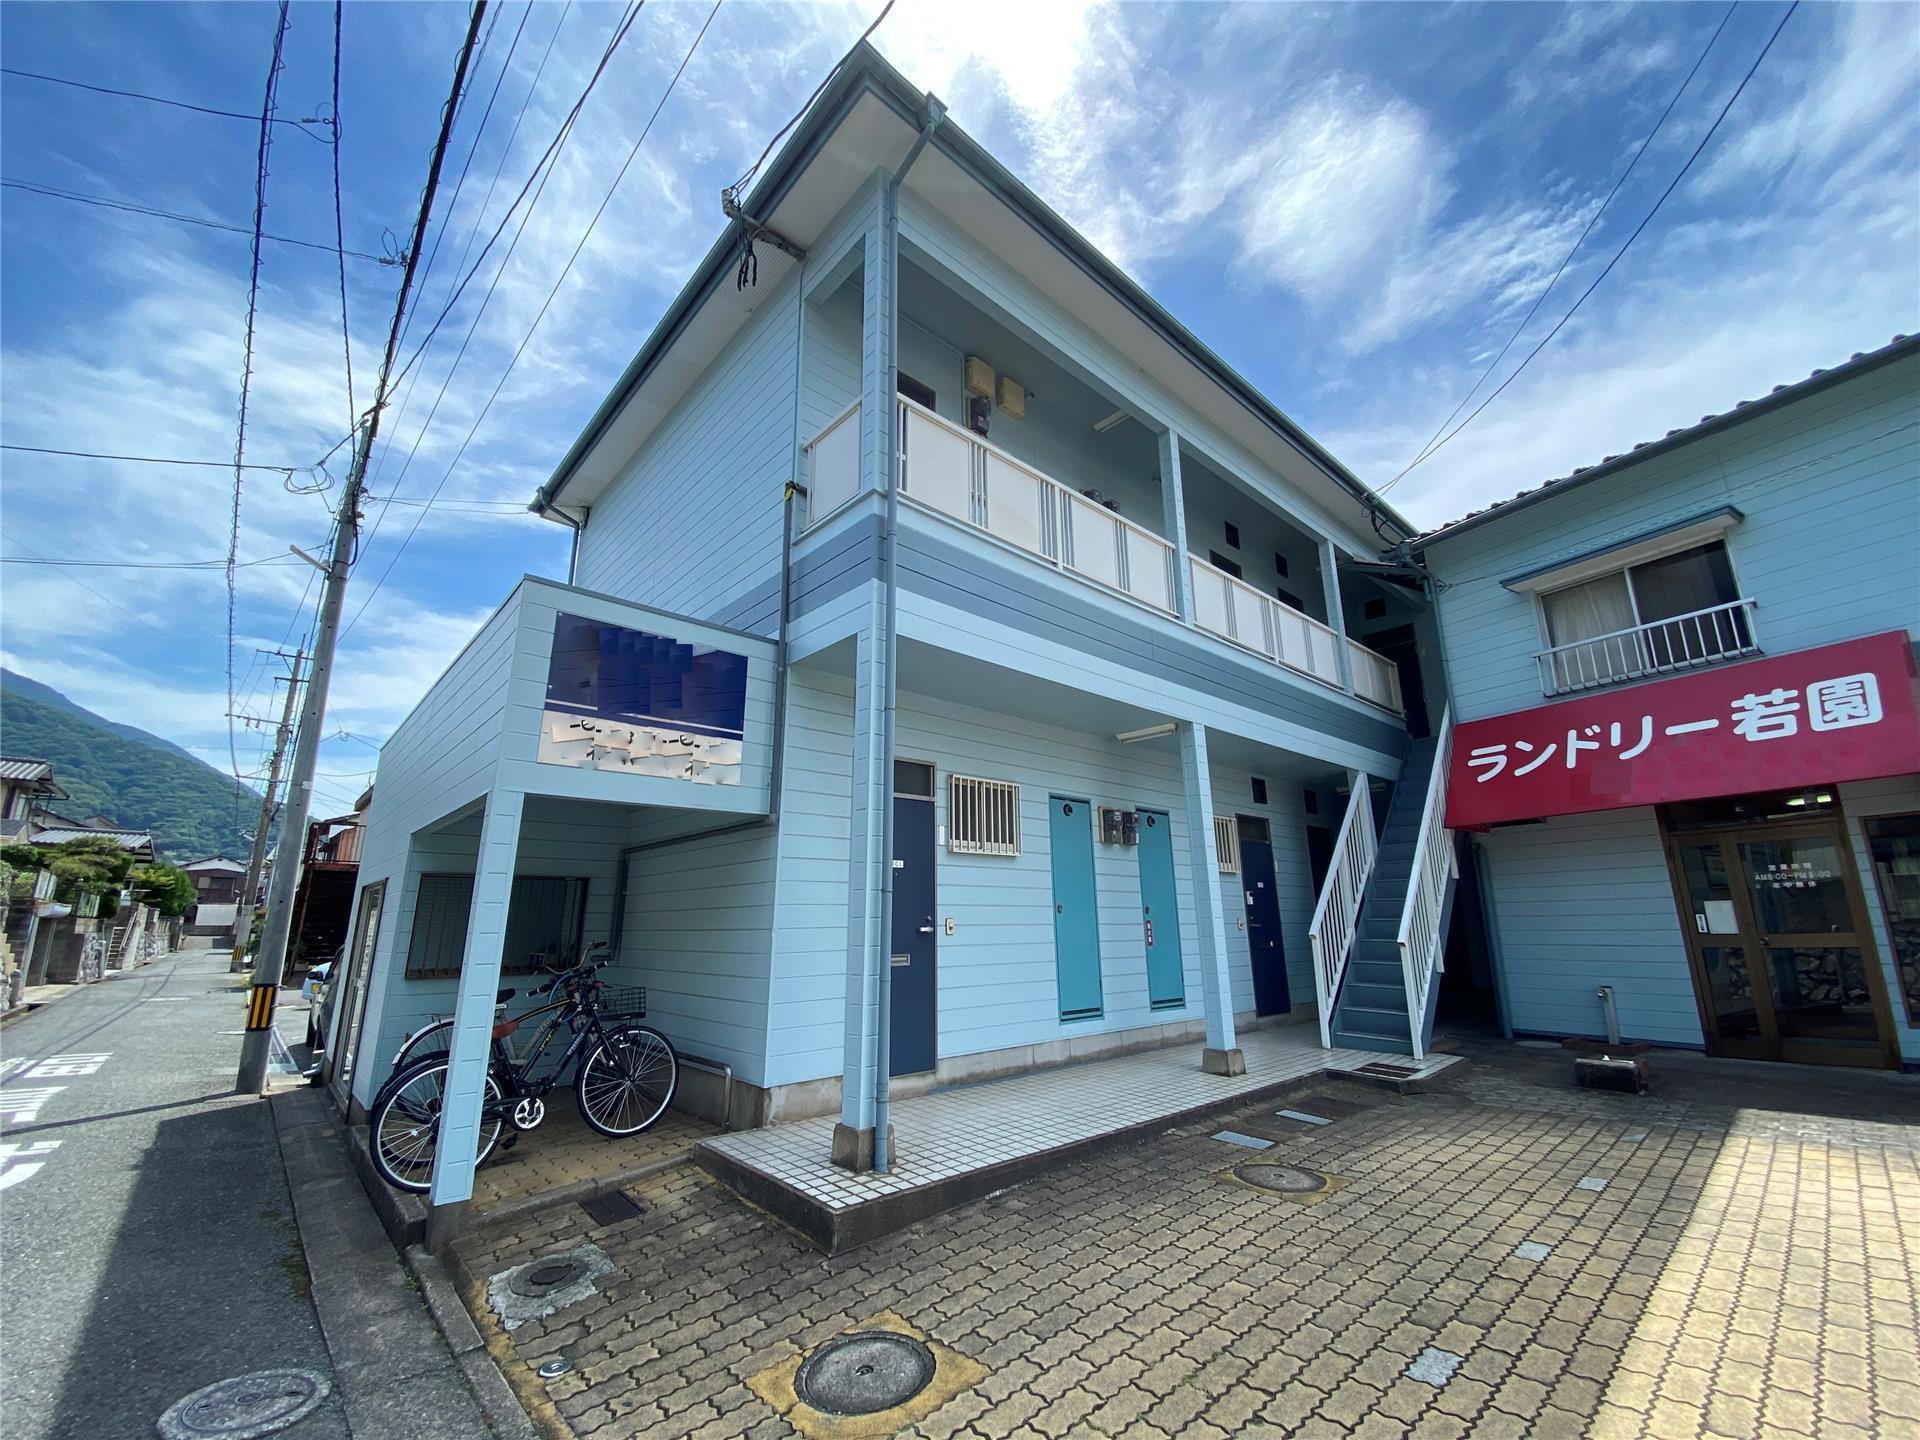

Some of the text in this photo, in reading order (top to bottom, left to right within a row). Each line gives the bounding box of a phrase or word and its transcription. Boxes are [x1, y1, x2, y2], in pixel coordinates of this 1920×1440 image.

[1467, 671, 1884, 784] ランドリー若園
